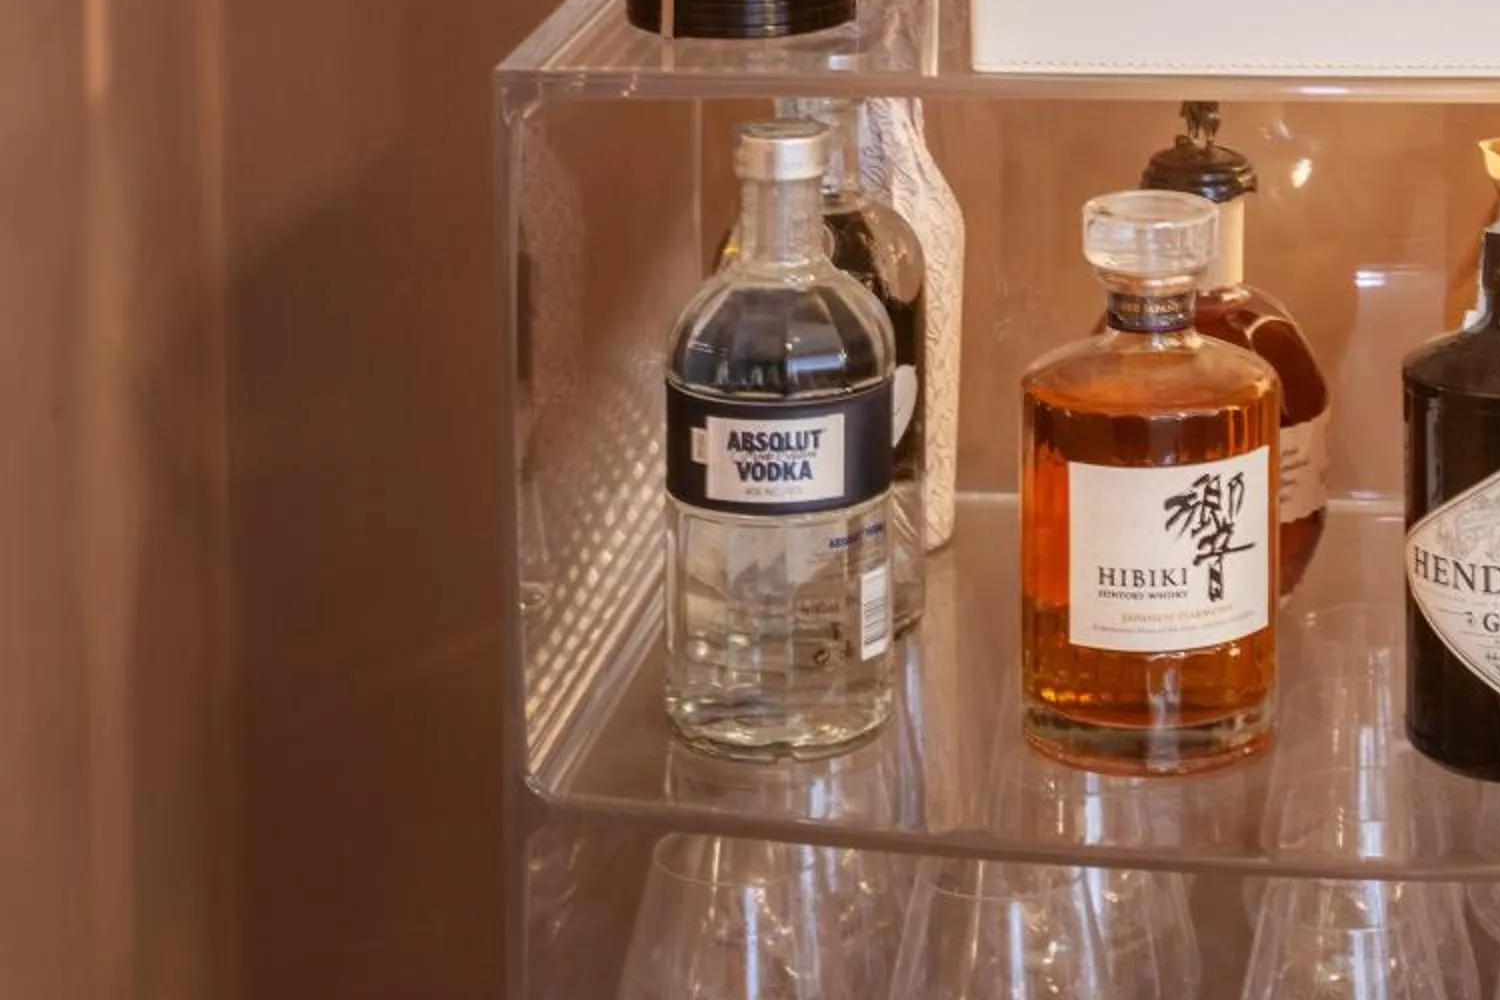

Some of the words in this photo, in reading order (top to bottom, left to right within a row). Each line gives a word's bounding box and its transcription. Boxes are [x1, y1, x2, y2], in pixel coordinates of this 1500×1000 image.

[727, 429, 823, 453] ABSOLUT
[735, 460, 814, 482] VODKA
[1097, 565, 1188, 588] HIBIKI
